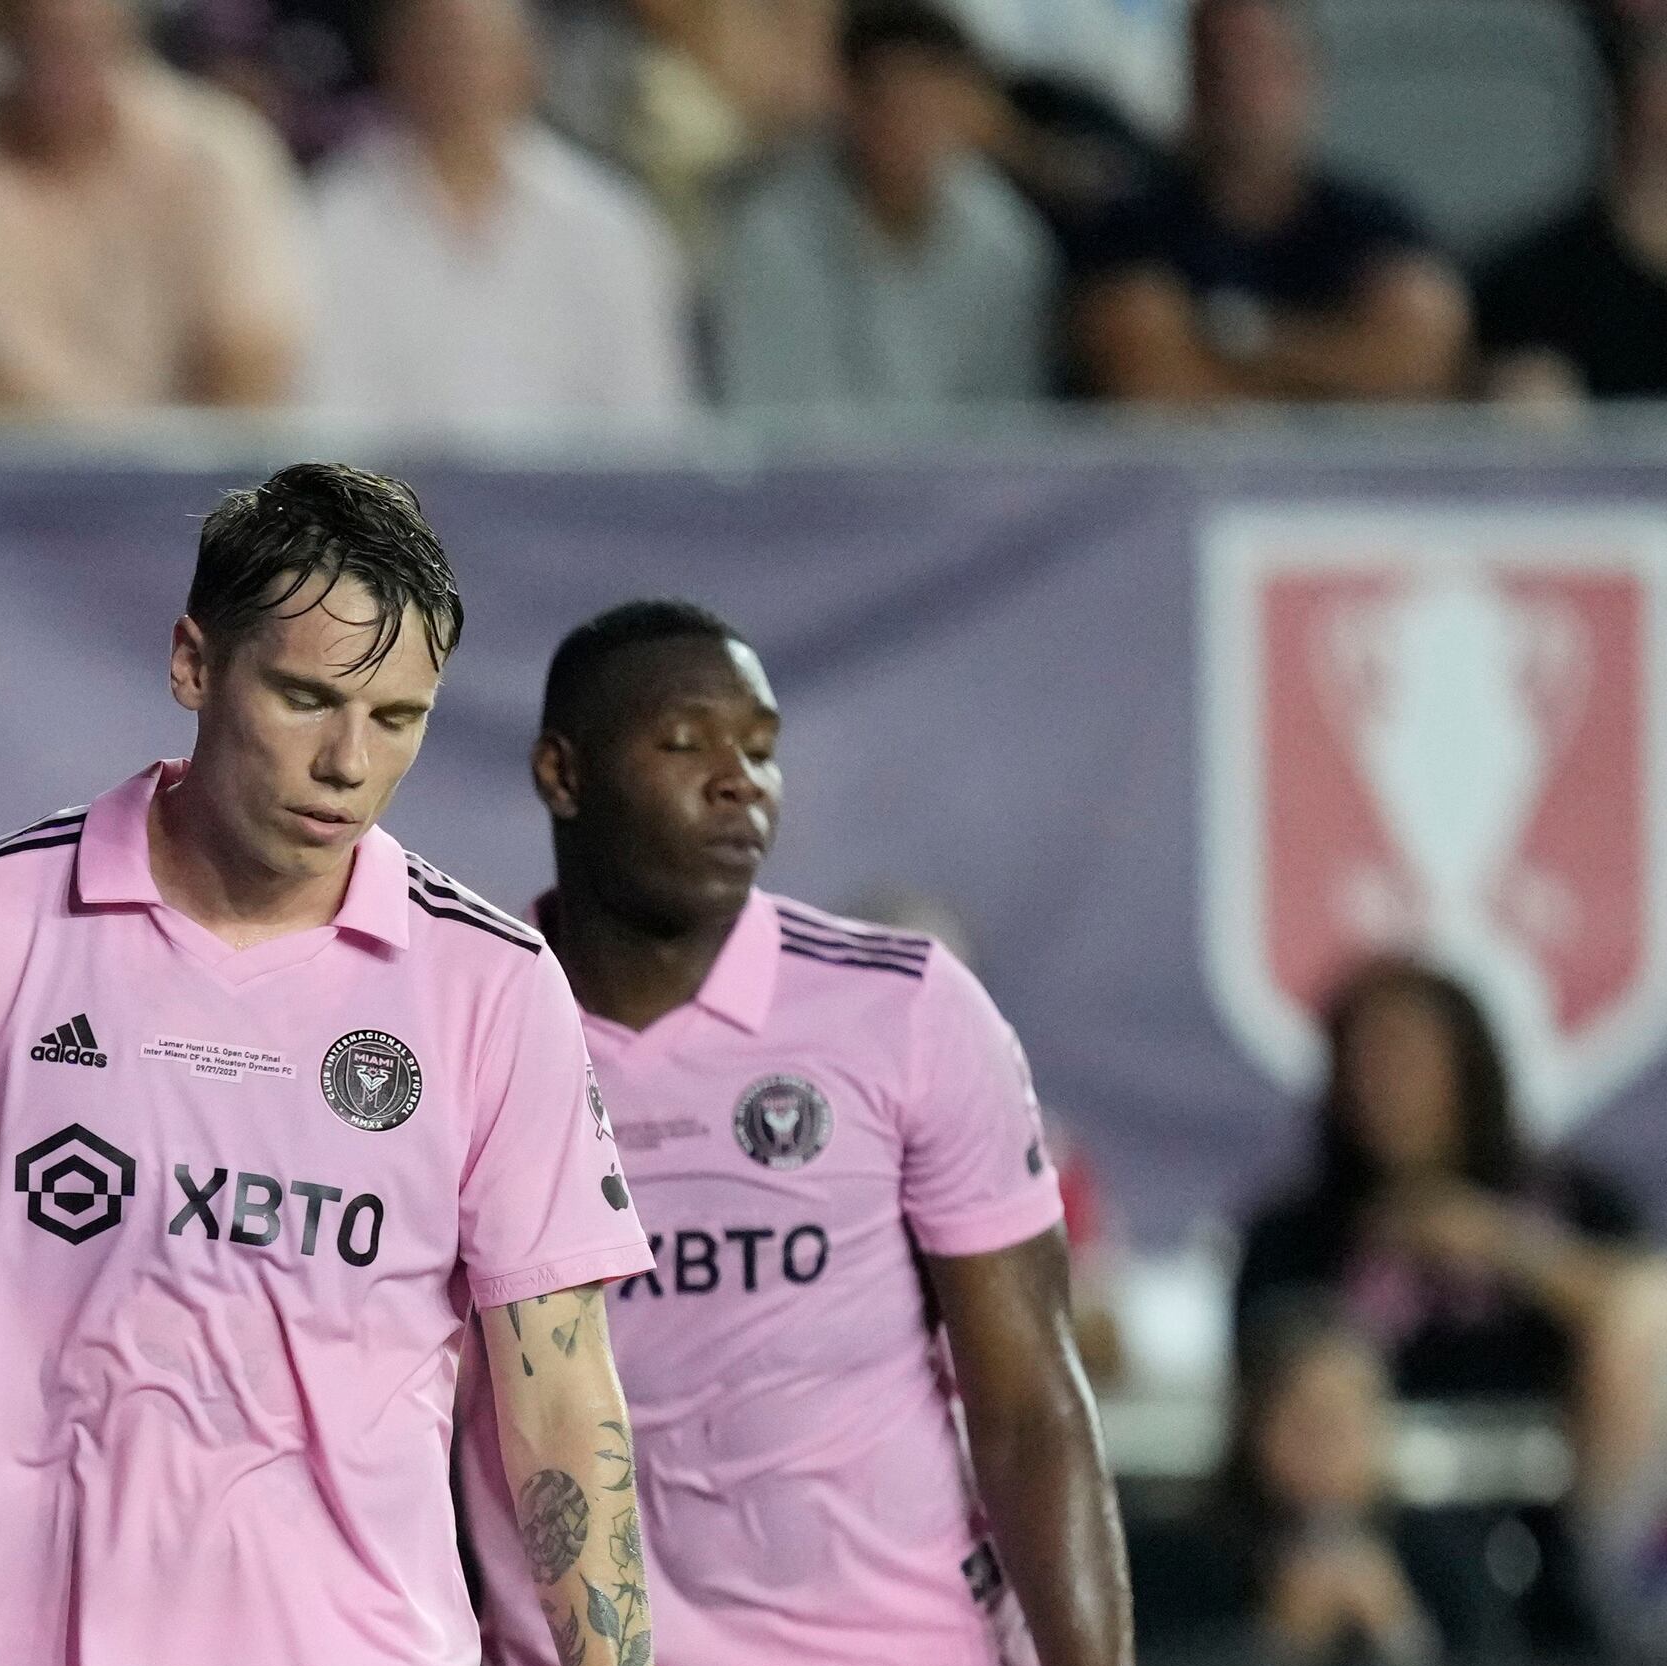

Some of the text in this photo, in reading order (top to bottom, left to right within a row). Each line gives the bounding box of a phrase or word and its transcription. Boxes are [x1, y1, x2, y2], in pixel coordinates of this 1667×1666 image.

[30, 1043, 108, 1069] adidas
[143, 1047, 162, 1056] Inter
[164, 1050, 188, 1059] Miami
[189, 1053, 200, 1061] CF
[214, 1057, 247, 1068] Houston
[248, 1062, 280, 1073] Dynamo
[281, 1067, 293, 1075] FC
[158, 1040, 281, 1063] Lamar Hunt U.S. Open Cup Final
[325, 1032, 408, 1067] INTERNACIONAL
[407, 1058, 419, 1072] DE
[353, 1053, 394, 1068] MIAMI
[195, 1064, 238, 1077] 09/27/2023
[350, 1115, 384, 1129] MMXX
[168, 1163, 384, 1268] XBTO
